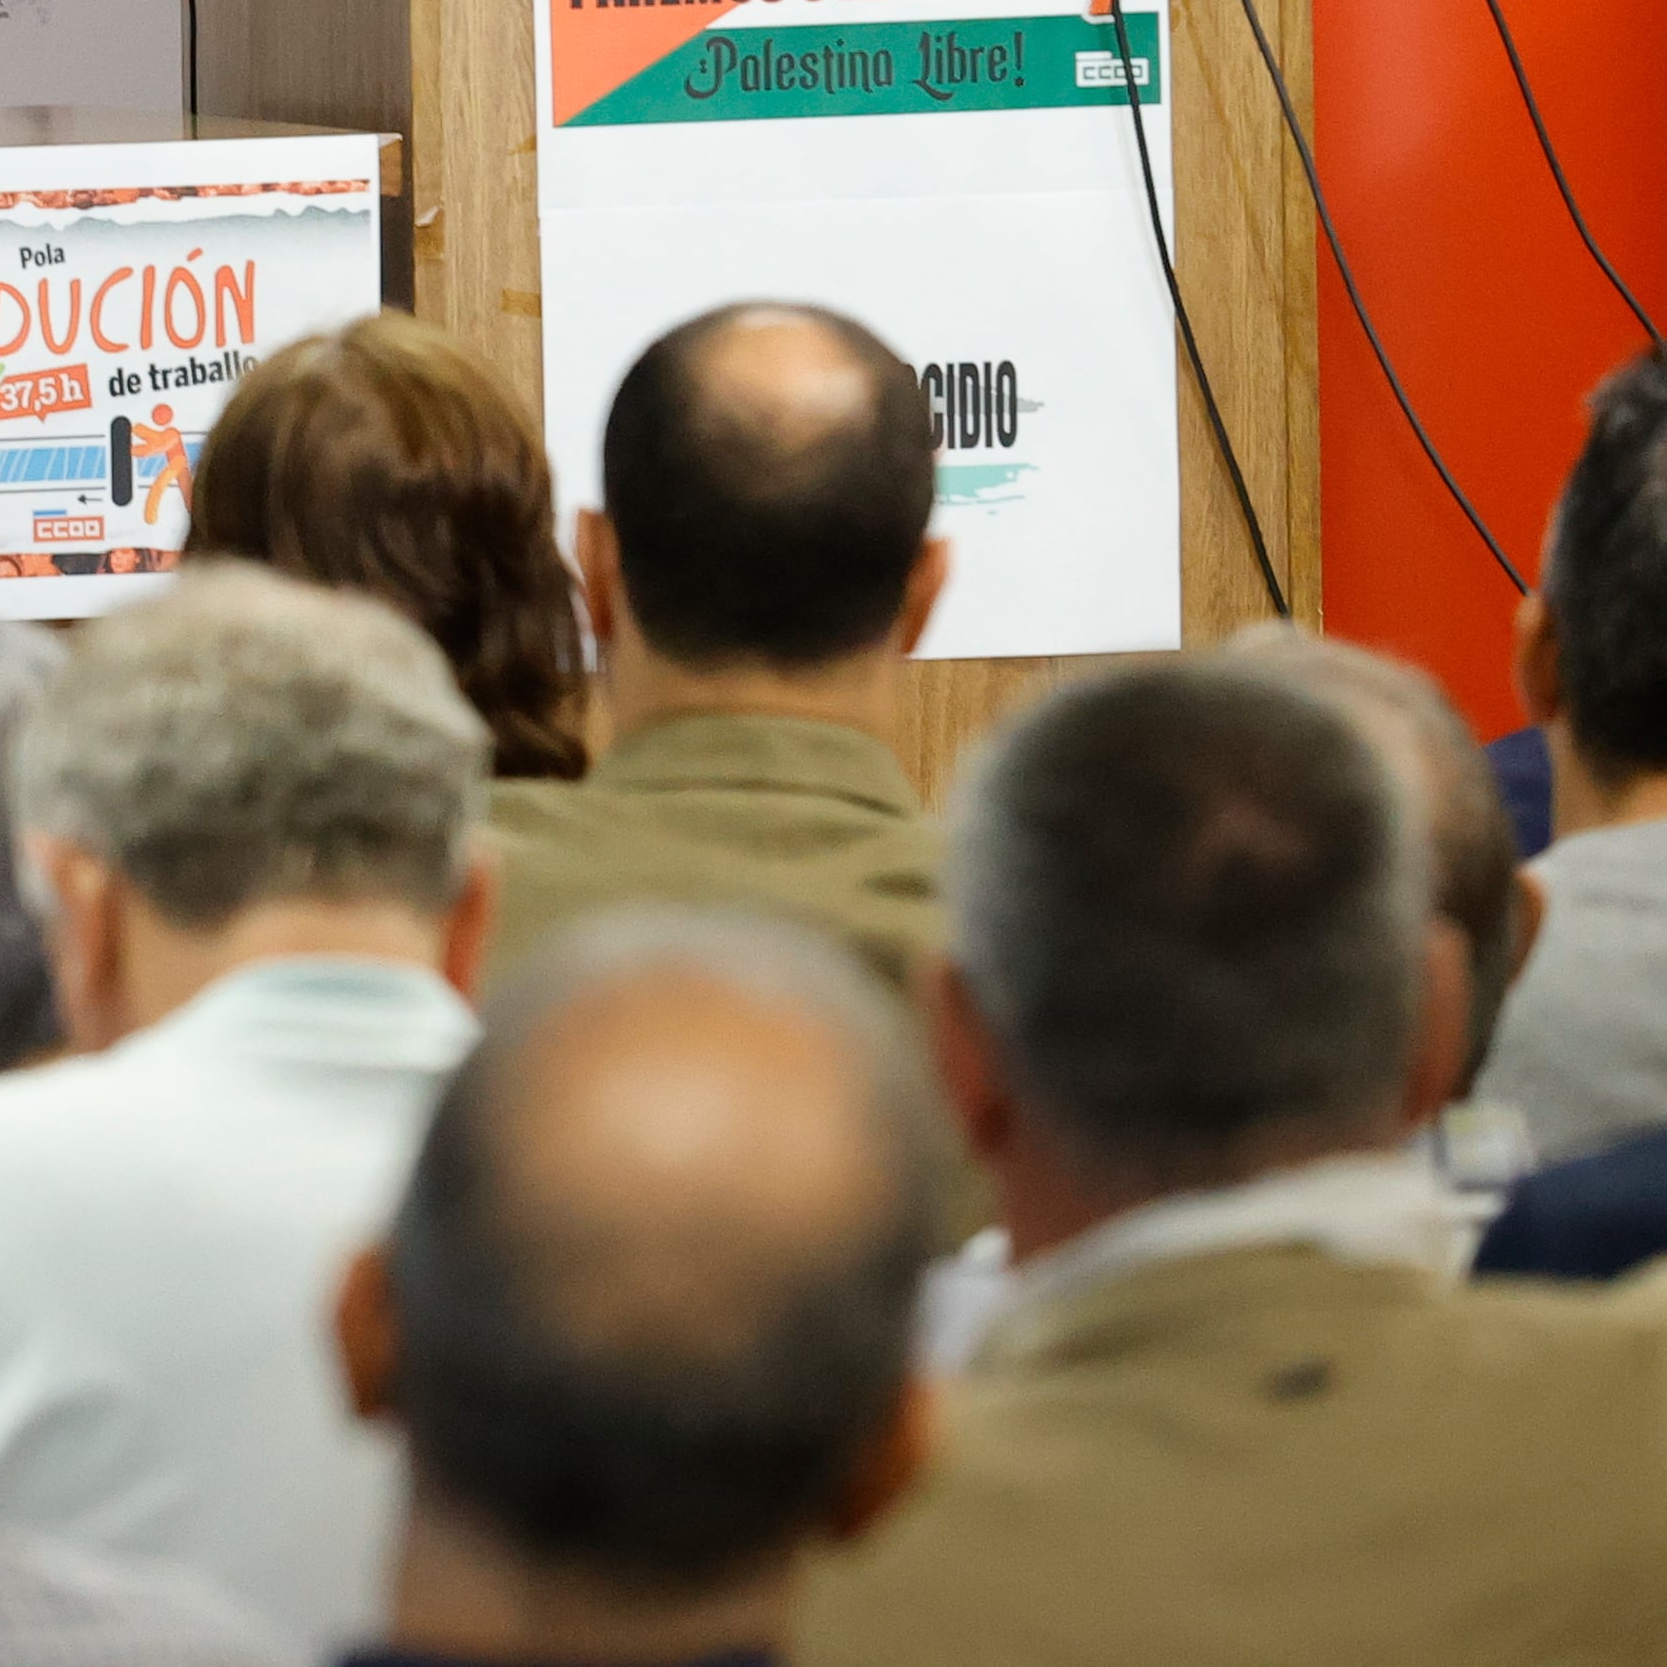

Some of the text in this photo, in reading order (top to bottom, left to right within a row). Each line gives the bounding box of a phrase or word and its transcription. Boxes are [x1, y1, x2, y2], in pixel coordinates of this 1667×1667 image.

[683, 30, 1026, 102] Palestina Libre!
[18, 243, 66, 269] Pola
[108, 367, 142, 398] de
[36, 519, 101, 540] CCOO
